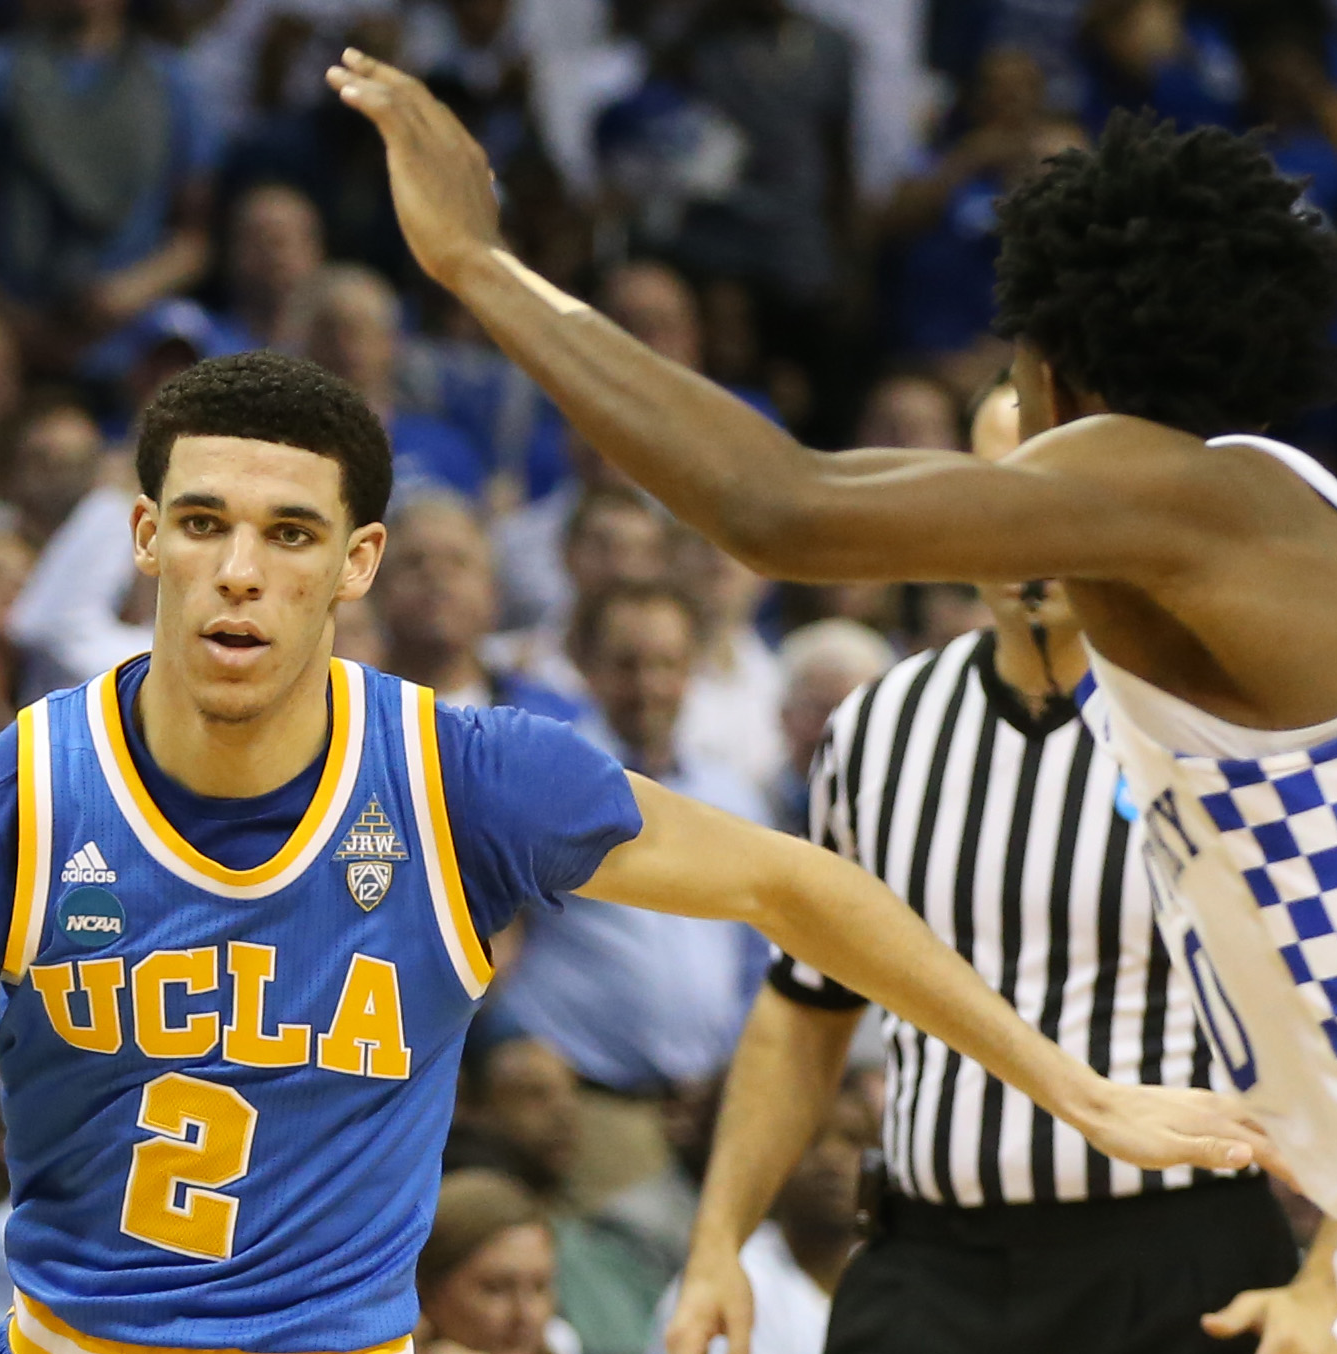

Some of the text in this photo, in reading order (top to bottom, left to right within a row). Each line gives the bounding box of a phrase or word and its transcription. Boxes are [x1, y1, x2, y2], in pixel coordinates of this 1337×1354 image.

[346, 834, 395, 853] JRW
[61, 868, 117, 883] adidas
[350, 864, 389, 892] PAC
[358, 882, 379, 901] 12
[66, 915, 122, 934] NCAA
[29, 940, 412, 1080] UCLA
[120, 1071, 259, 1262] 2
